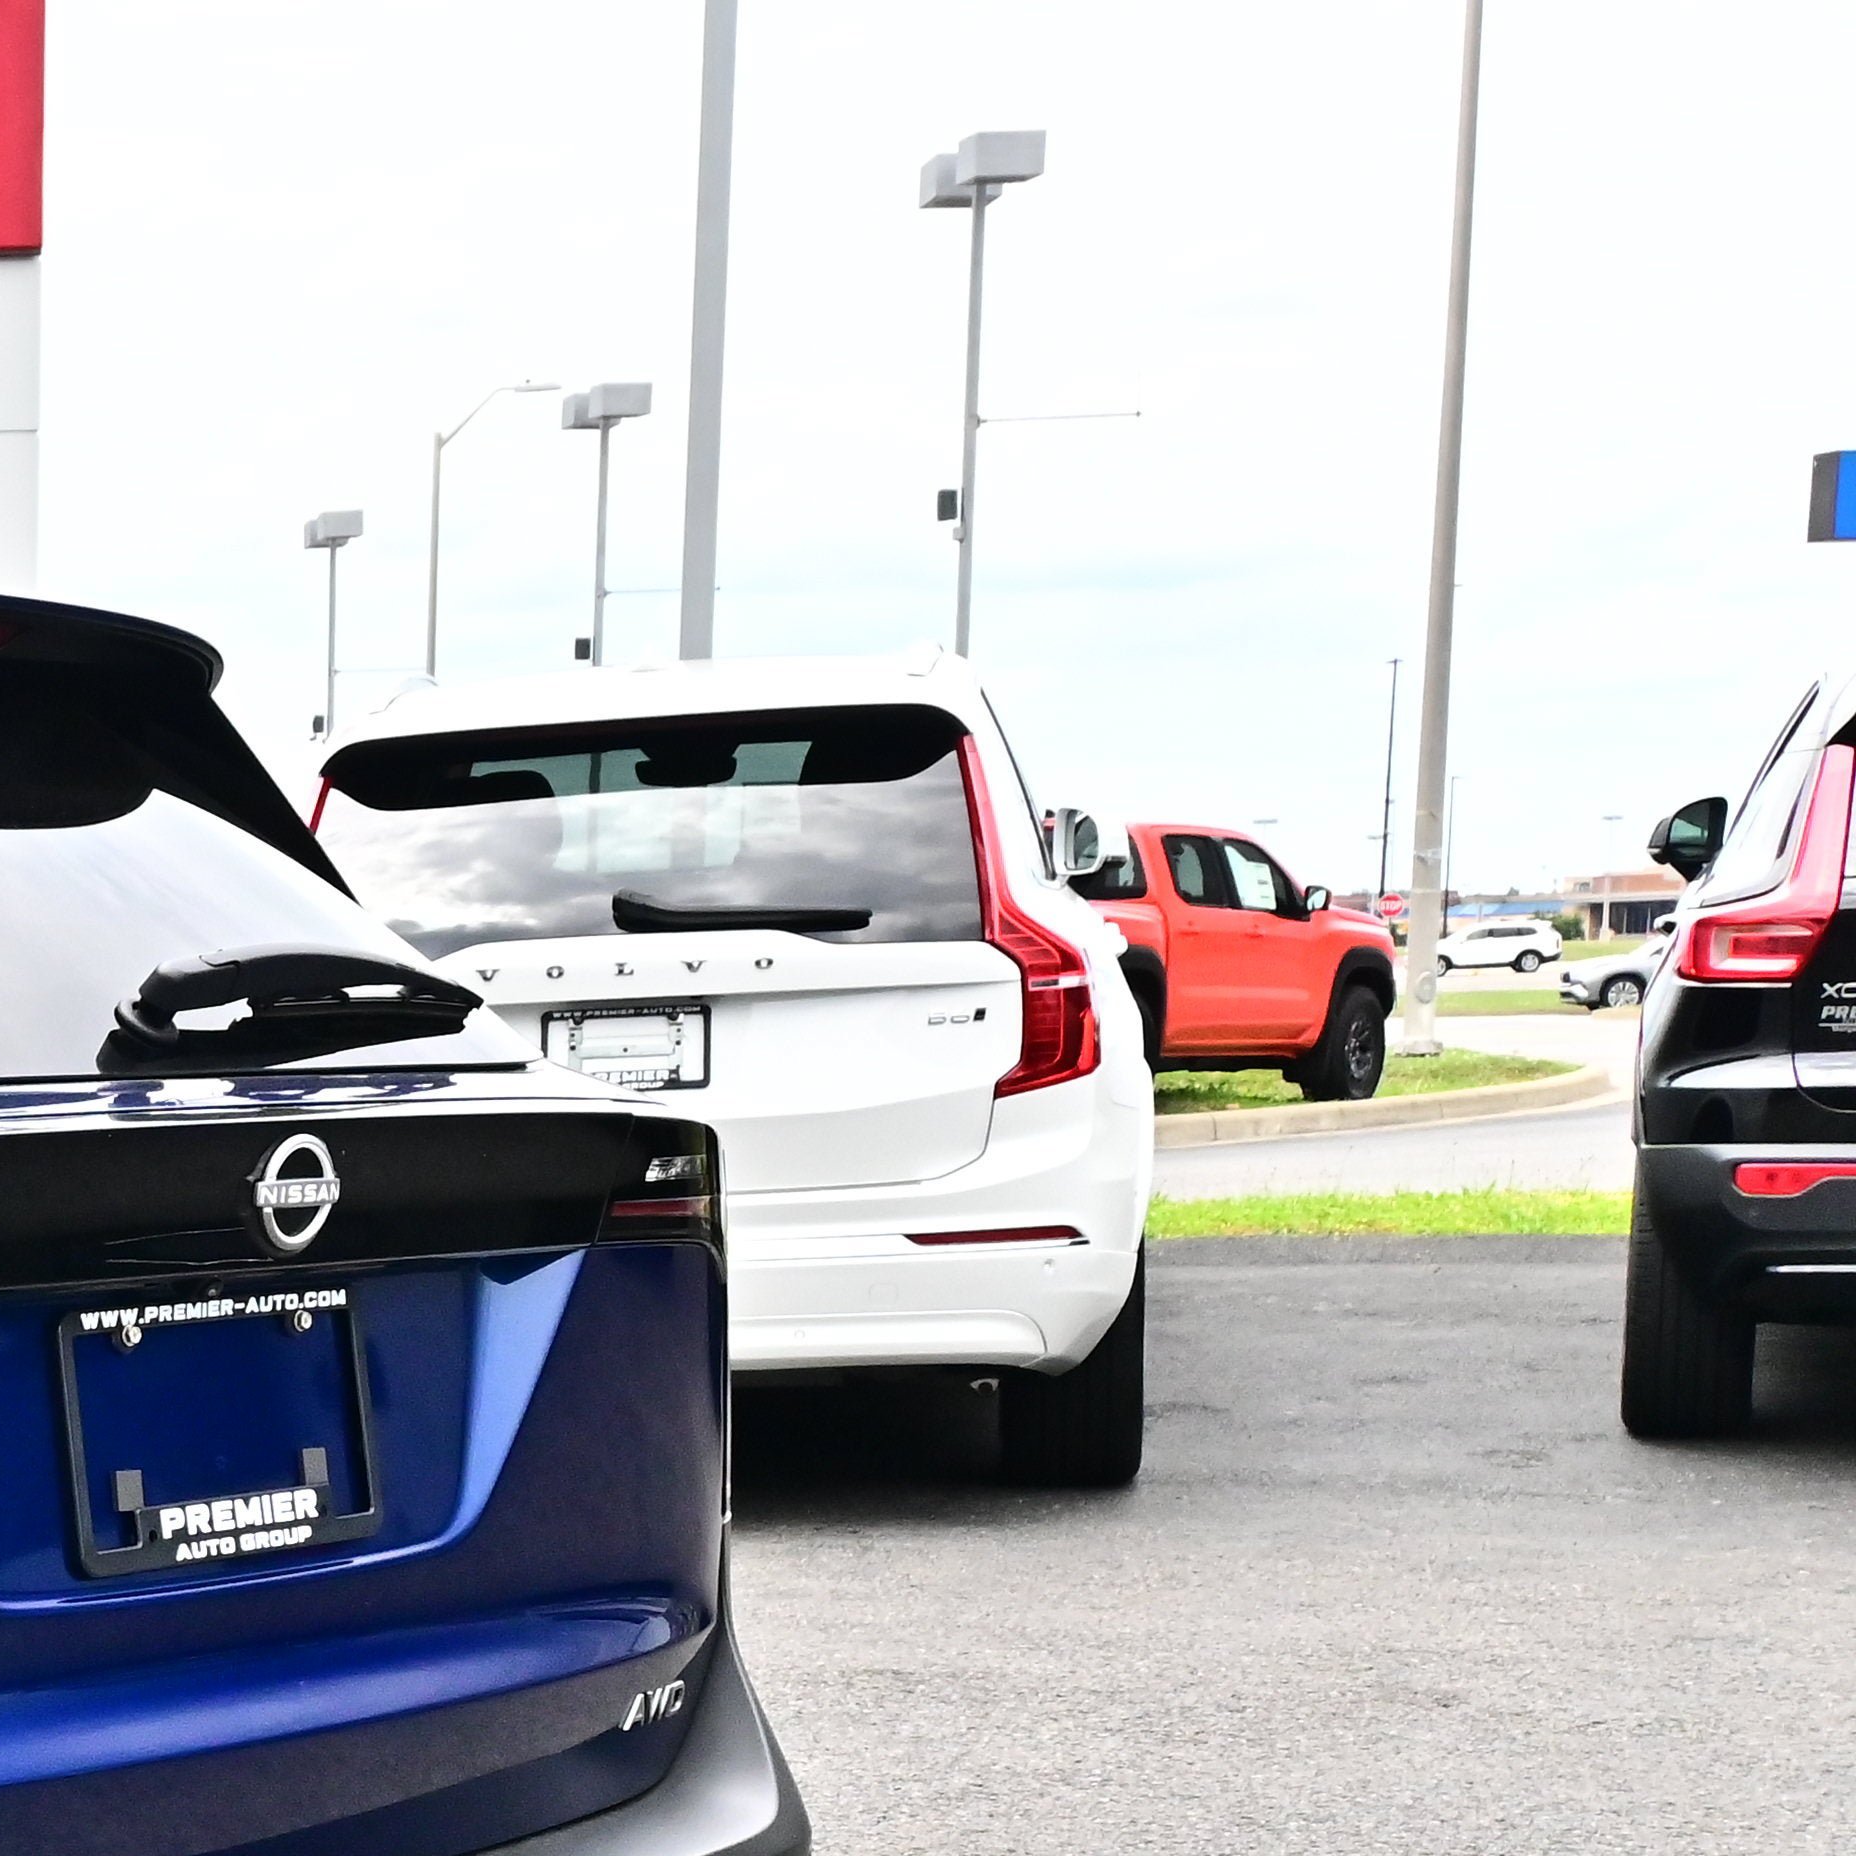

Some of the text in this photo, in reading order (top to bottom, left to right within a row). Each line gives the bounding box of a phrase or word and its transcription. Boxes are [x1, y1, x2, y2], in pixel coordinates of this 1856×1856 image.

[476, 957, 774, 983] VOLVO
[552, 1005, 702, 1019] WWW.PREMIER-AUTO.COM
[593, 1070, 669, 1084] REMIER
[259, 1182, 340, 1205] NISSAN
[80, 1288, 347, 1331] WWW.PREMIER-AUTO.COM
[159, 1488, 320, 1540] PREMIER
[175, 1525, 313, 1562] AUTO GROUP
[621, 1679, 686, 1732] AWD
